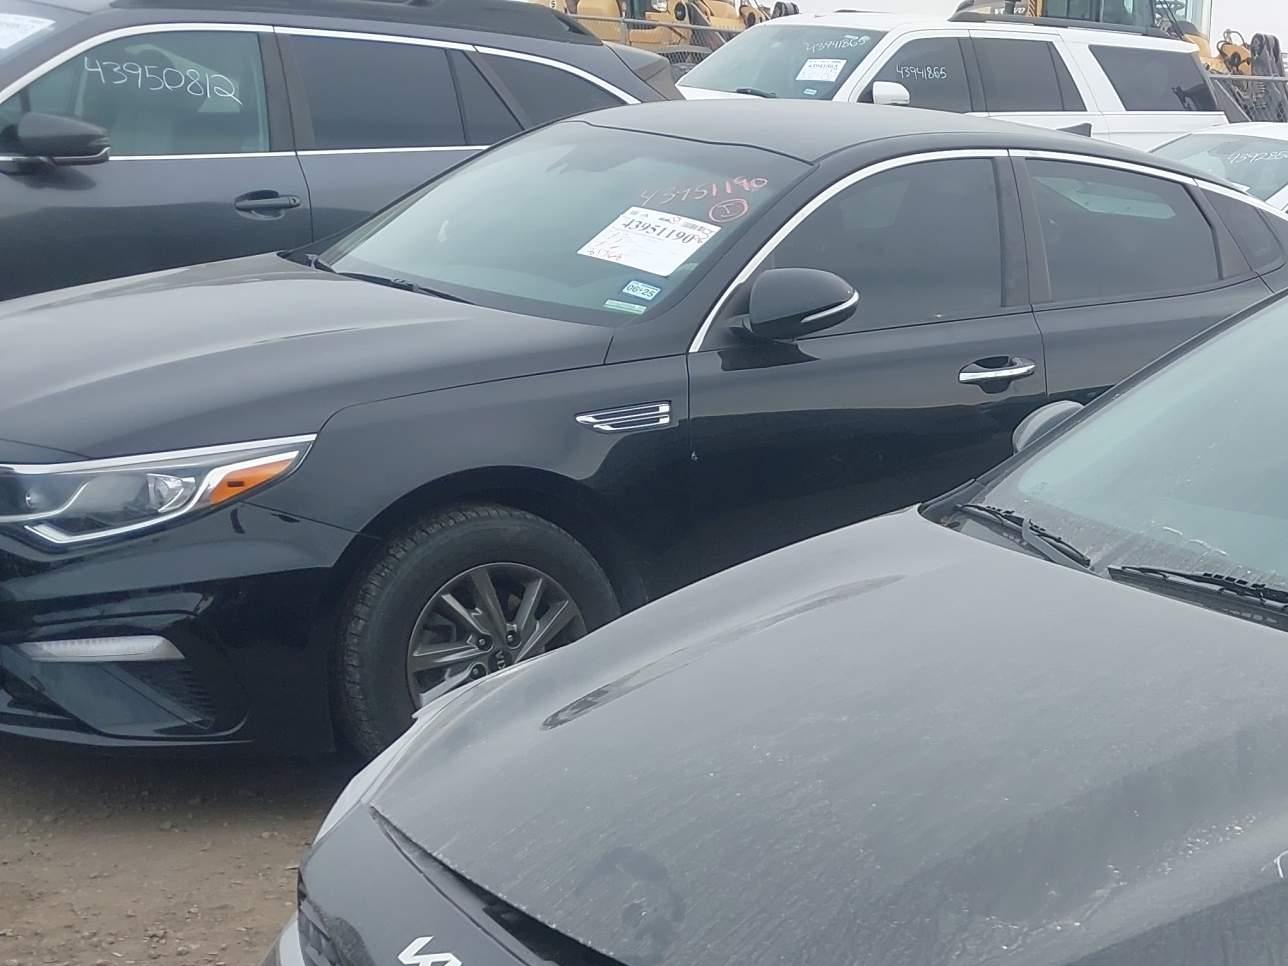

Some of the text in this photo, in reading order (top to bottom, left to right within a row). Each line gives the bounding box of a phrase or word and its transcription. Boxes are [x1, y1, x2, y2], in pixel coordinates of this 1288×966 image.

[84, 56, 243, 105] 43950812
[896, 64, 948, 80] 43941865
[622, 218, 696, 244] 43951190
